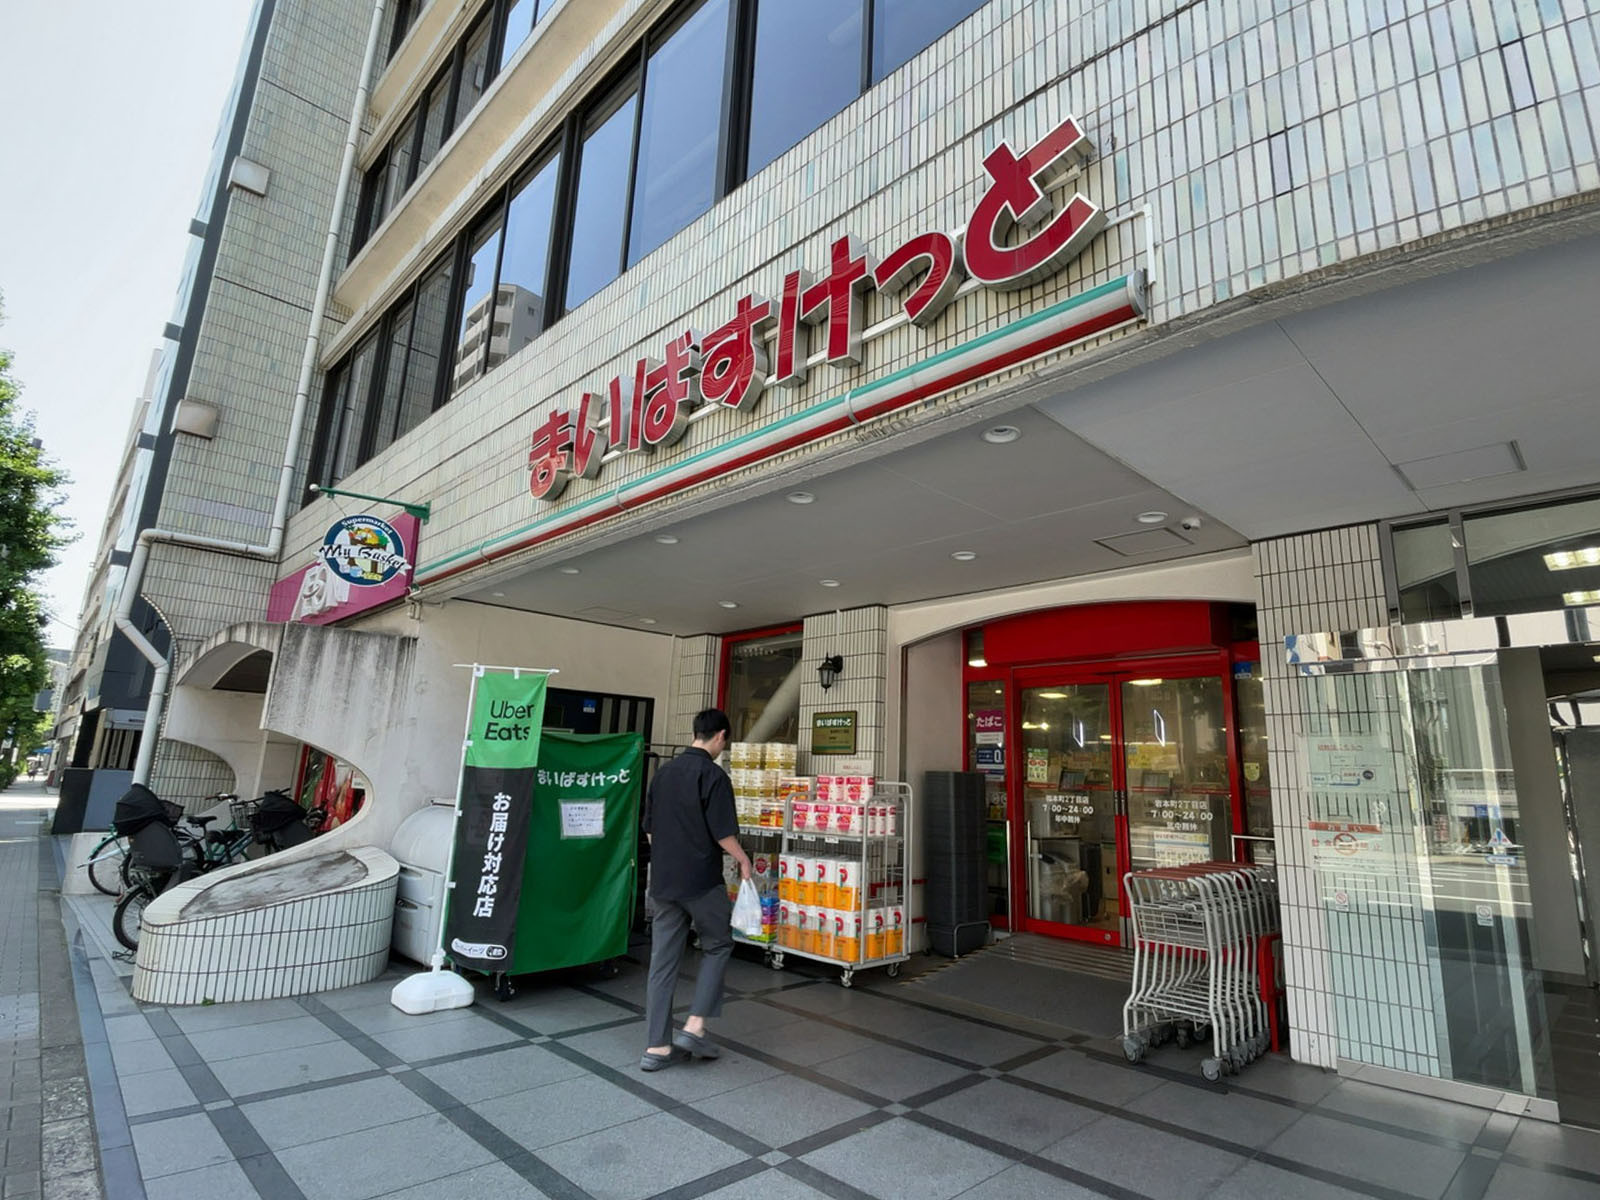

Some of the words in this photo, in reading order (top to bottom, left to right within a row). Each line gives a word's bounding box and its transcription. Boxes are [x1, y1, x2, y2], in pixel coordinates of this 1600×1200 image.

[528, 114, 1104, 501] まいばすけっと
[341, 517, 393, 534] Supermarket
[319, 543, 351, 560] My
[490, 700, 534, 719] Uber
[975, 715, 1003, 728] たばこ
[484, 722, 530, 741] Eats
[537, 768, 630, 788] まいばすけっと
[473, 792, 512, 918] お届け対応店
